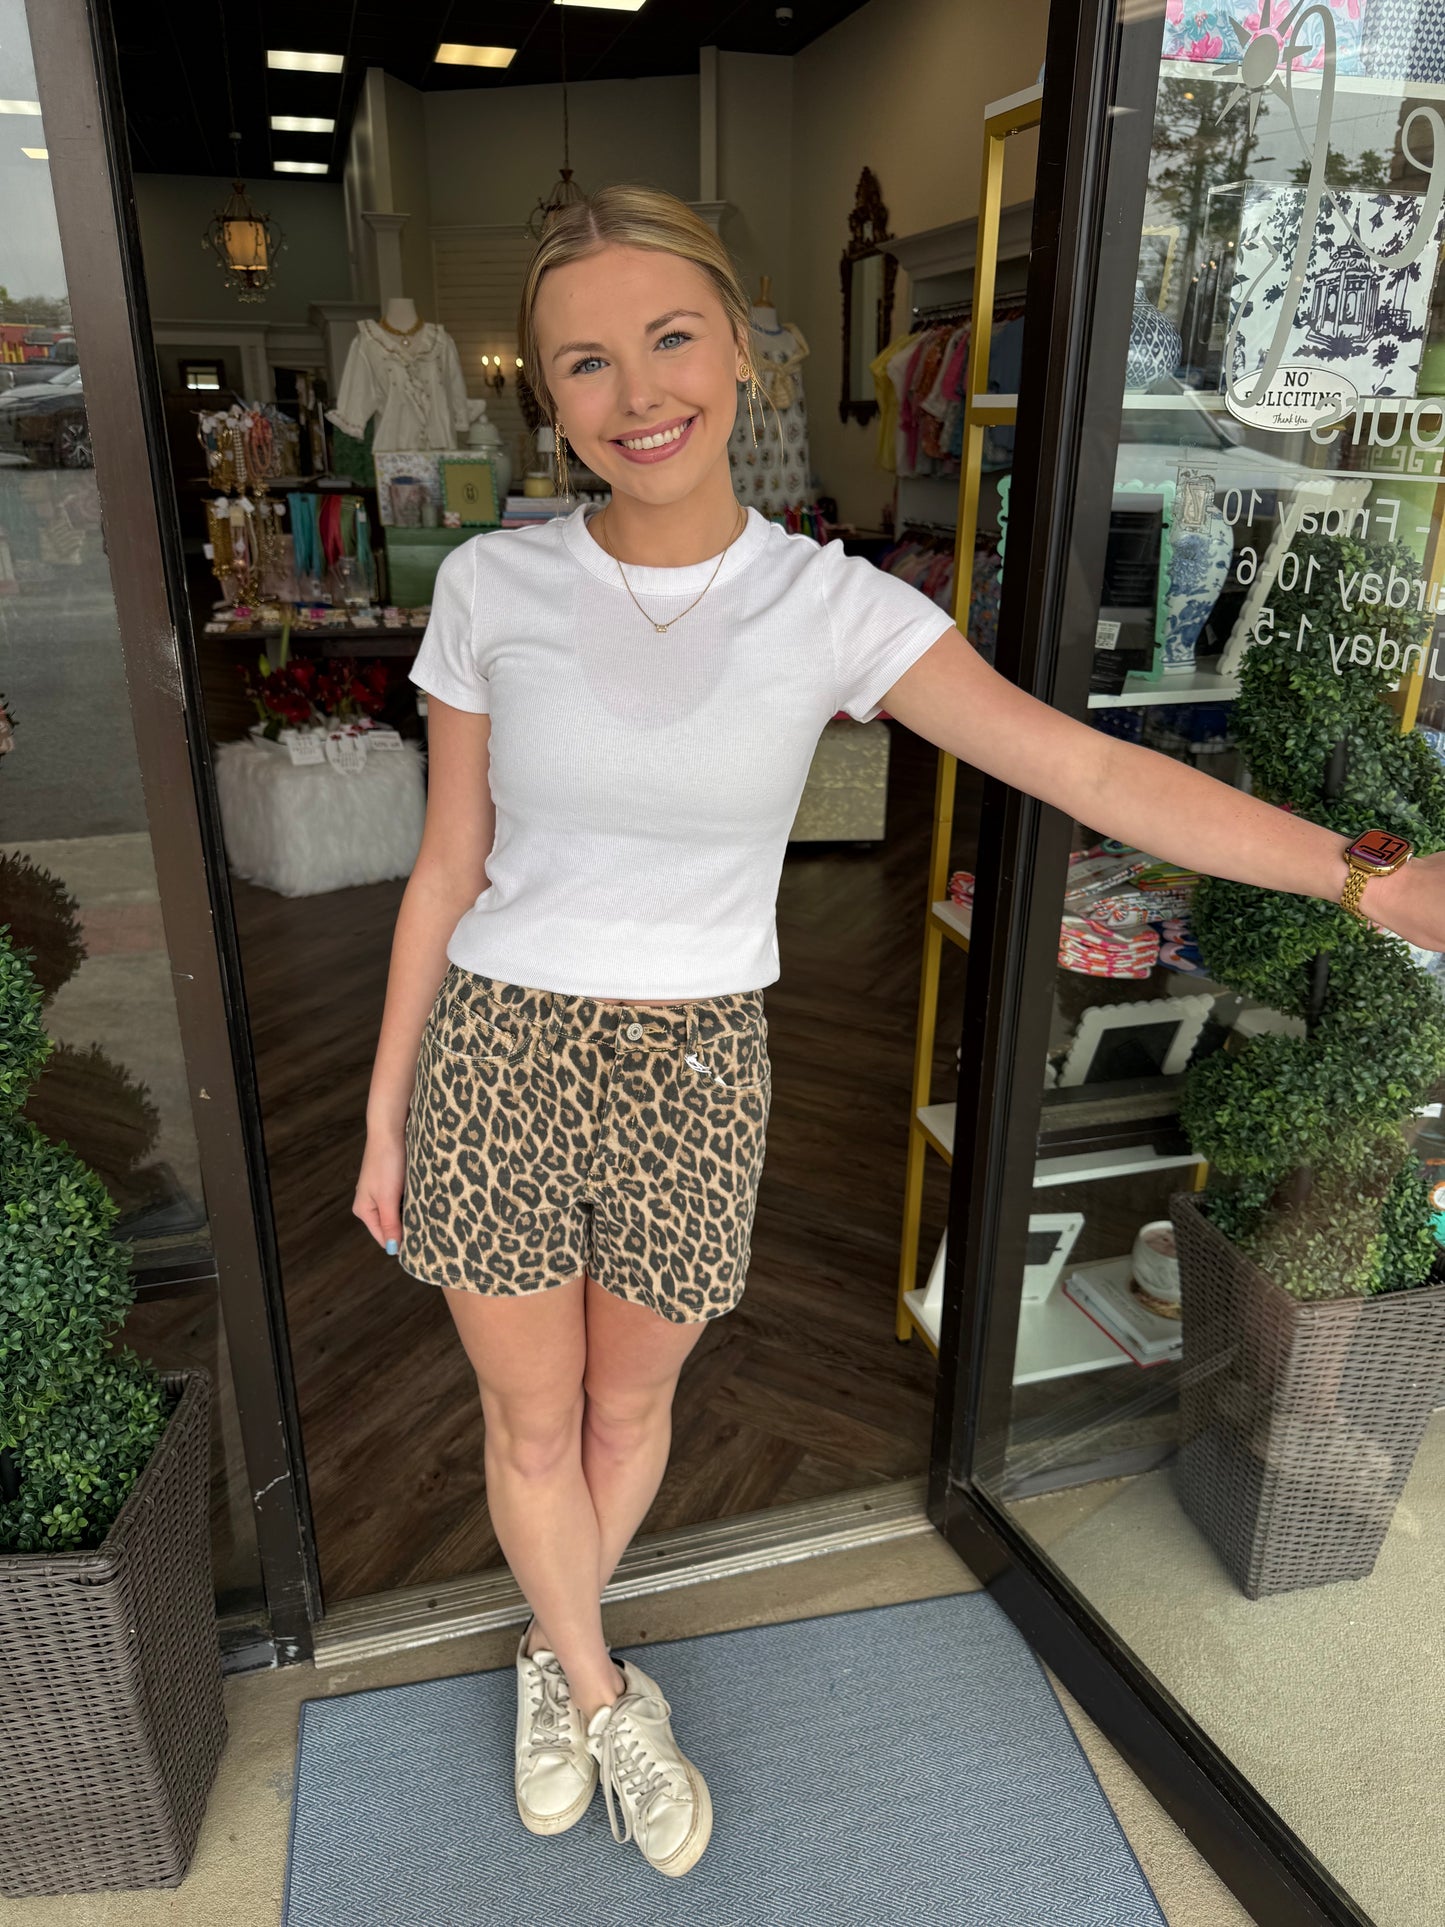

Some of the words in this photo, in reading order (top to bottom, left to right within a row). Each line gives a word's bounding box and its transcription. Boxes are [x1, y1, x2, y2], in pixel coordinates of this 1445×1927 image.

[1284, 371, 1309, 387] NO
[1272, 413, 1294, 424] Thank
[1295, 415, 1308, 426] You
